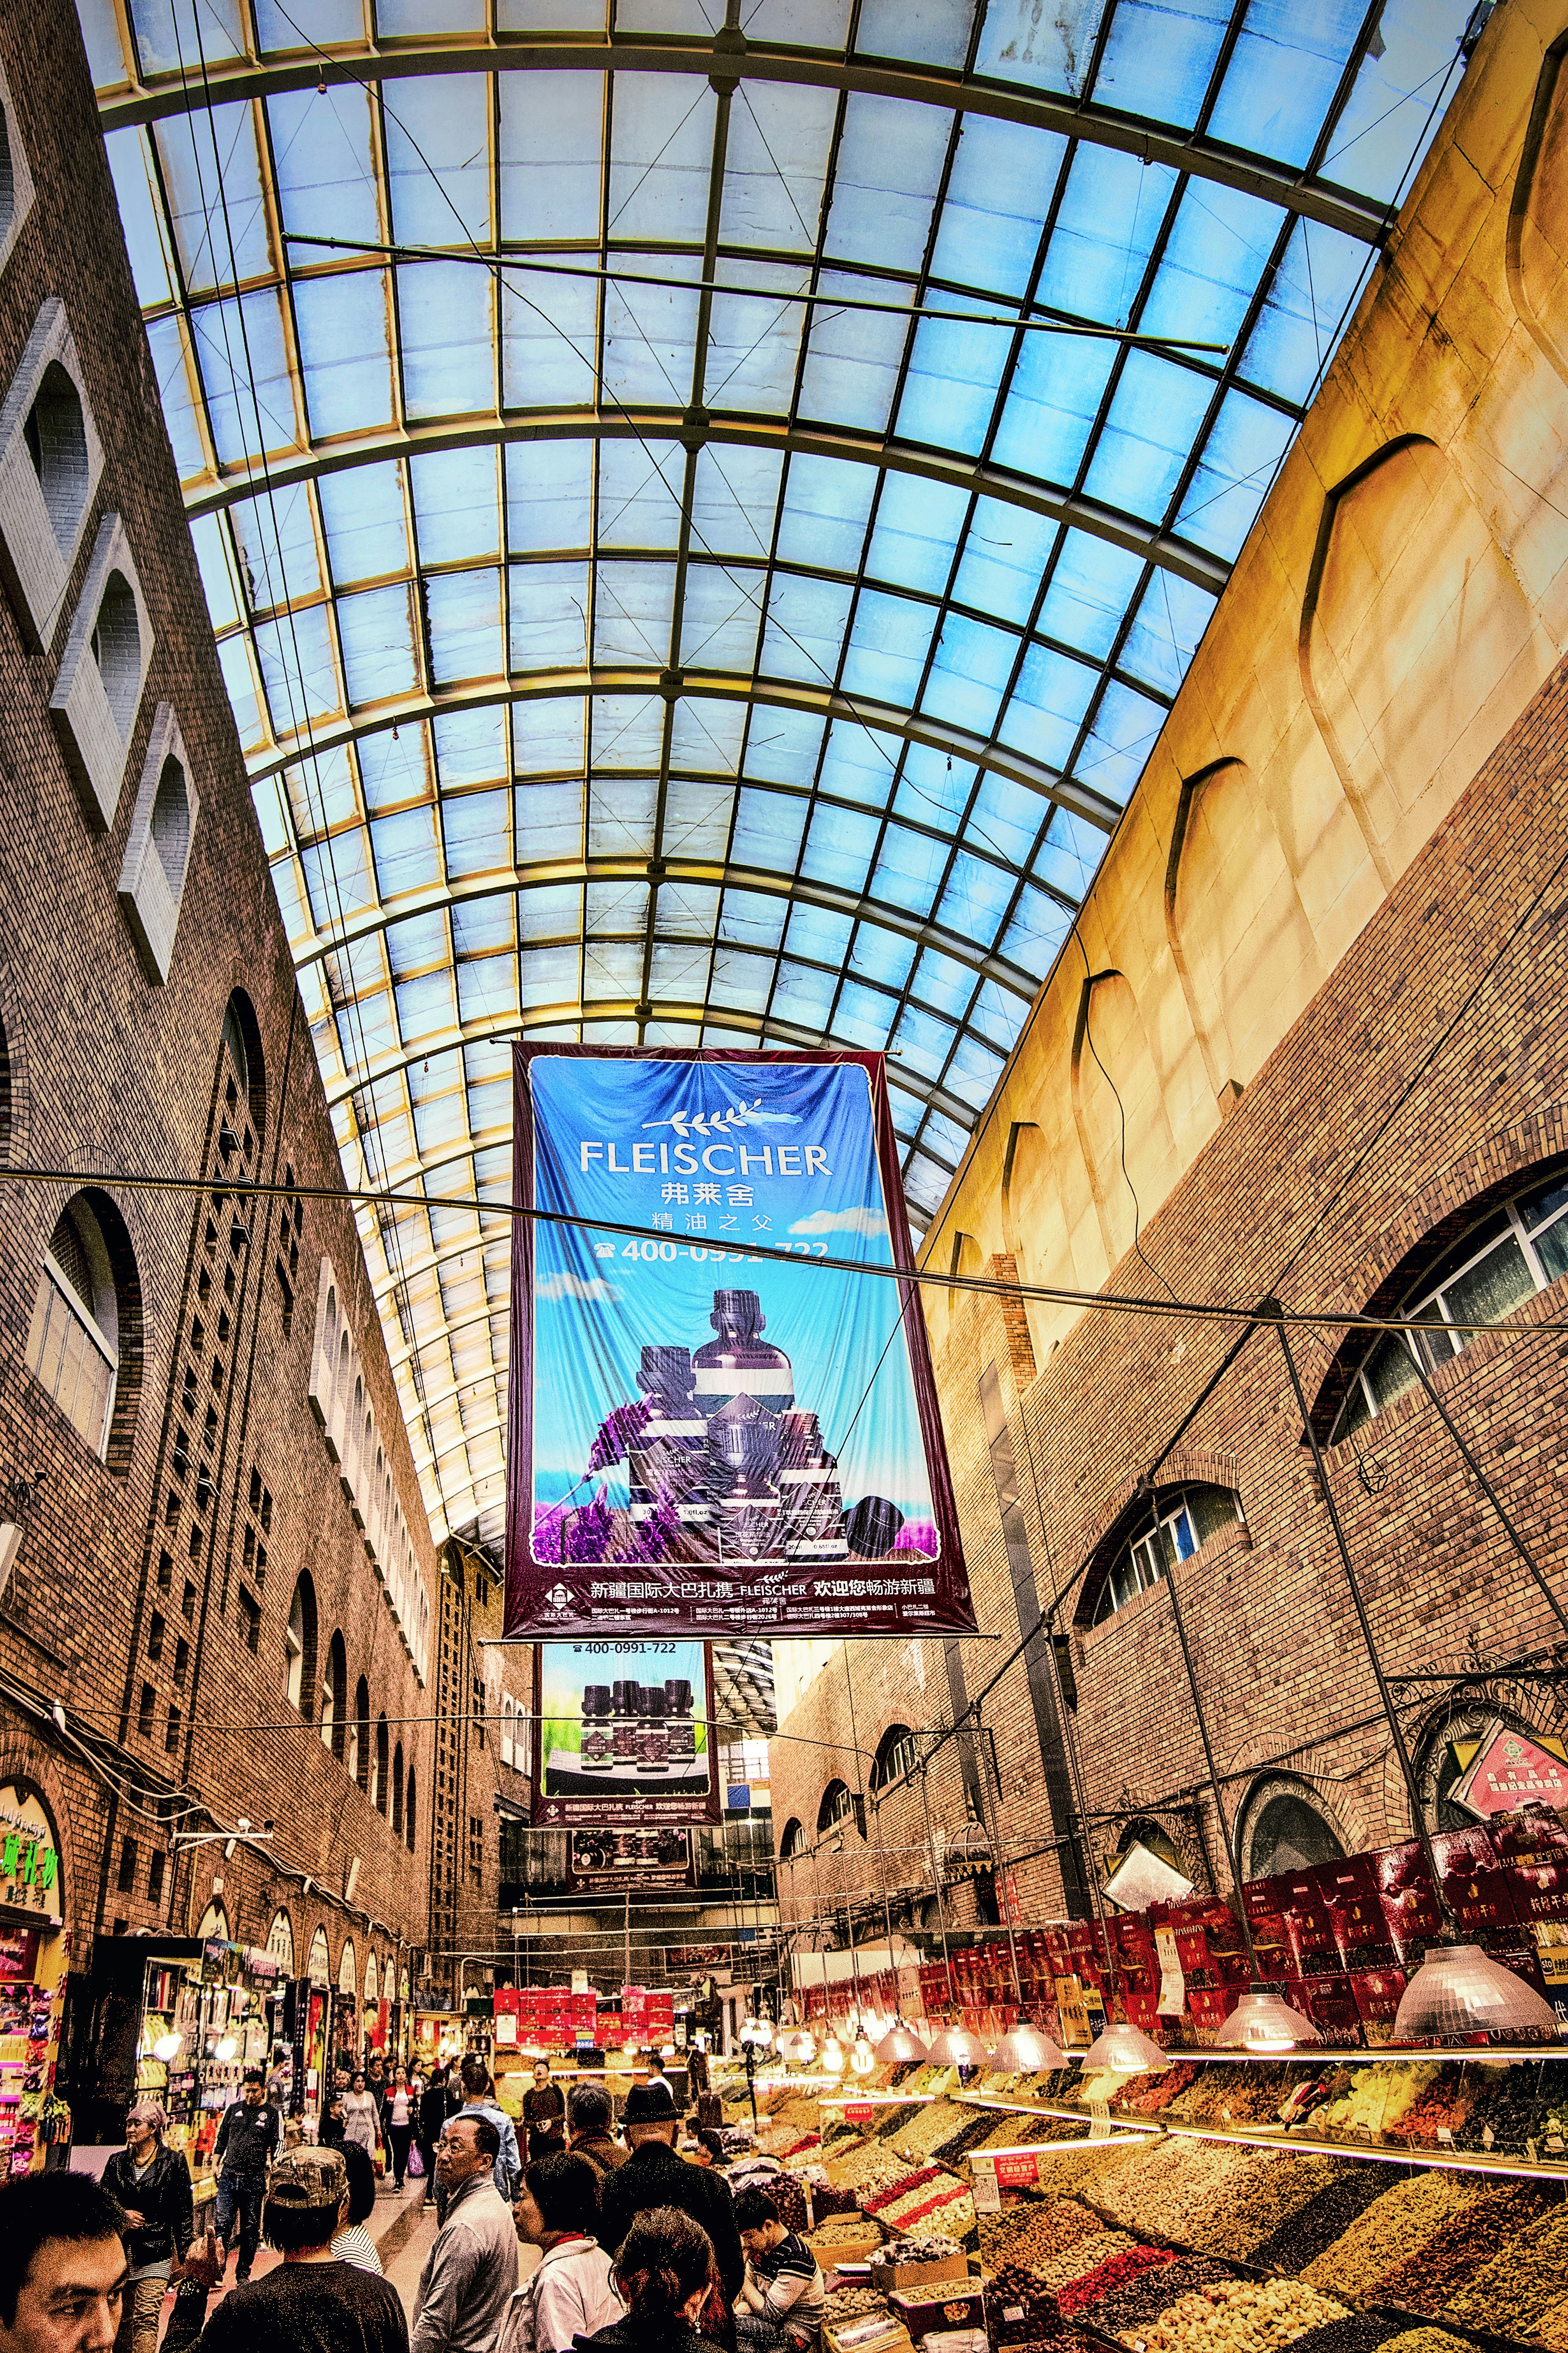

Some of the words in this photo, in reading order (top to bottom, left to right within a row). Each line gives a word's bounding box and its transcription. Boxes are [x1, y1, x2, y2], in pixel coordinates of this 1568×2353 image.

[580, 1142, 833, 1176] FLEISCHER
[660, 1182, 755, 1207] 弗莱舍
[652, 1212, 773, 1231] 精油之父
[621, 1240, 829, 1263] 400-0991722
[590, 1582, 733, 1599] 新疆国际大巴扎携
[740, 1584, 807, 1597] FLEISCHER
[813, 1578, 936, 1597] 欢迎您畅游新疆
[585, 1643, 676, 1654] 400-0991-722
